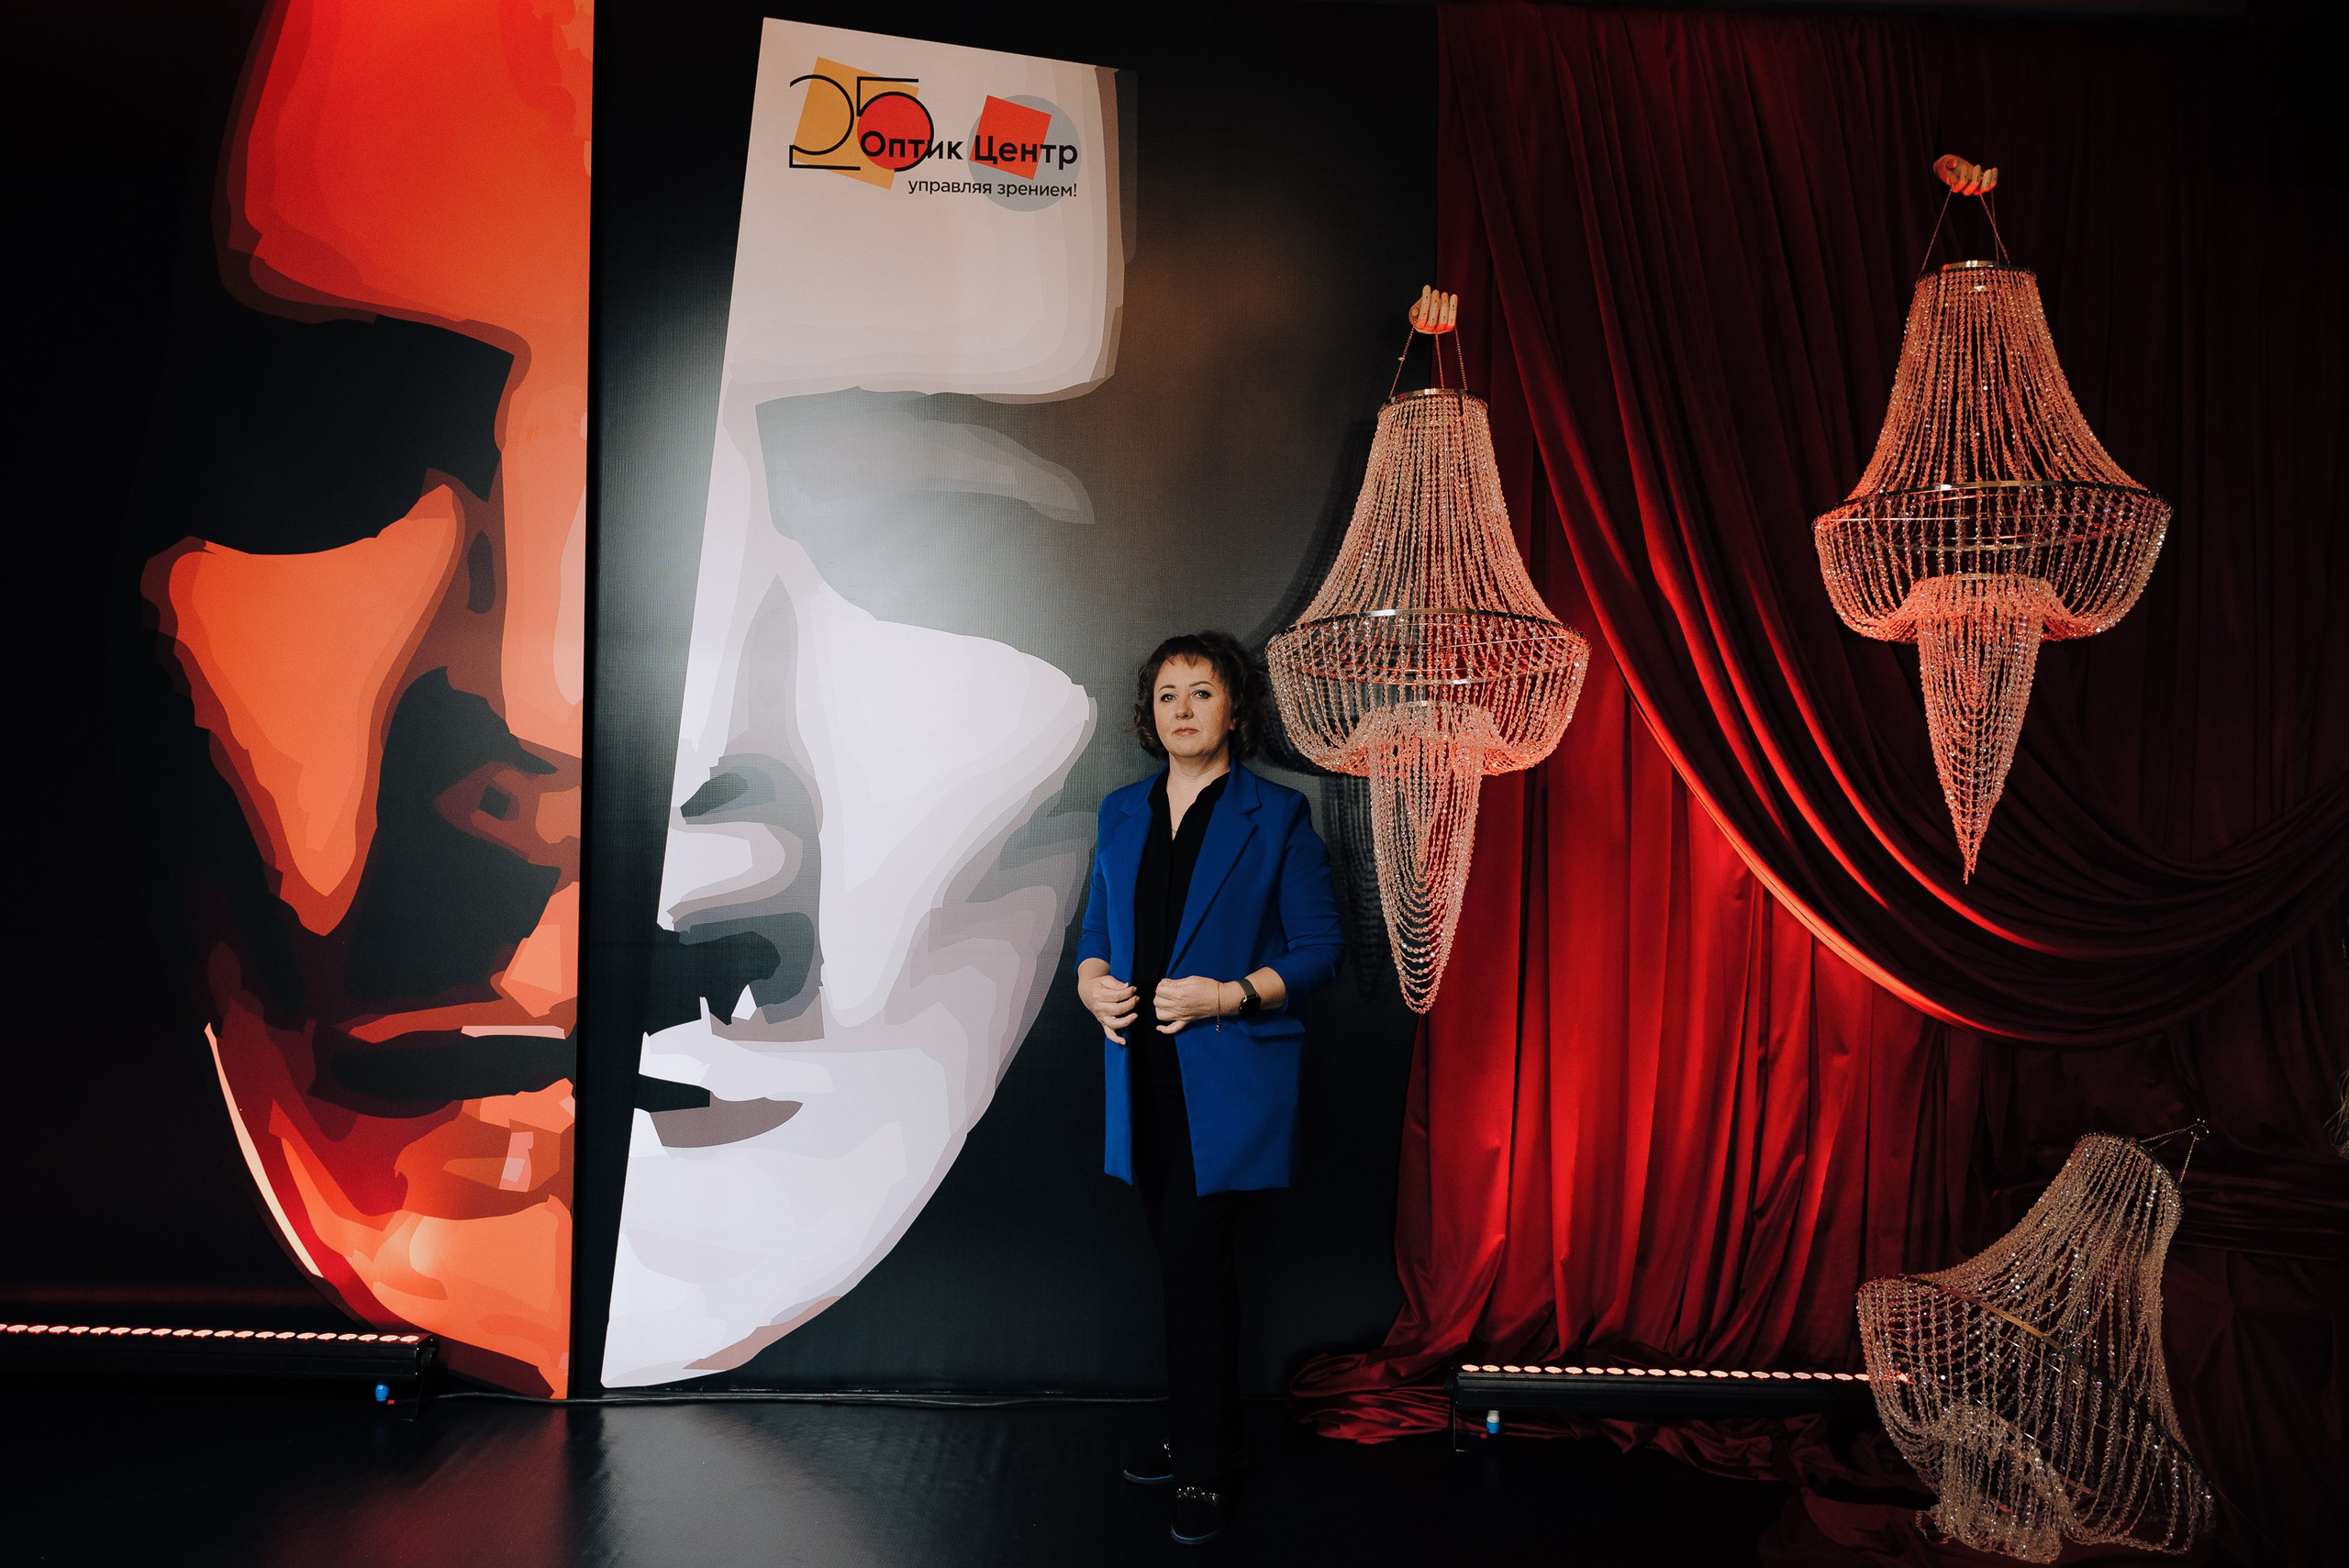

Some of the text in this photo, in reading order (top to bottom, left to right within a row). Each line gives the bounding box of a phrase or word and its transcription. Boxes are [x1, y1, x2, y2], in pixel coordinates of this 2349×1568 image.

[789, 74, 934, 172] 25
[861, 130, 1078, 170] Оптик Центр
[907, 179, 1078, 197] управляя зрением!
